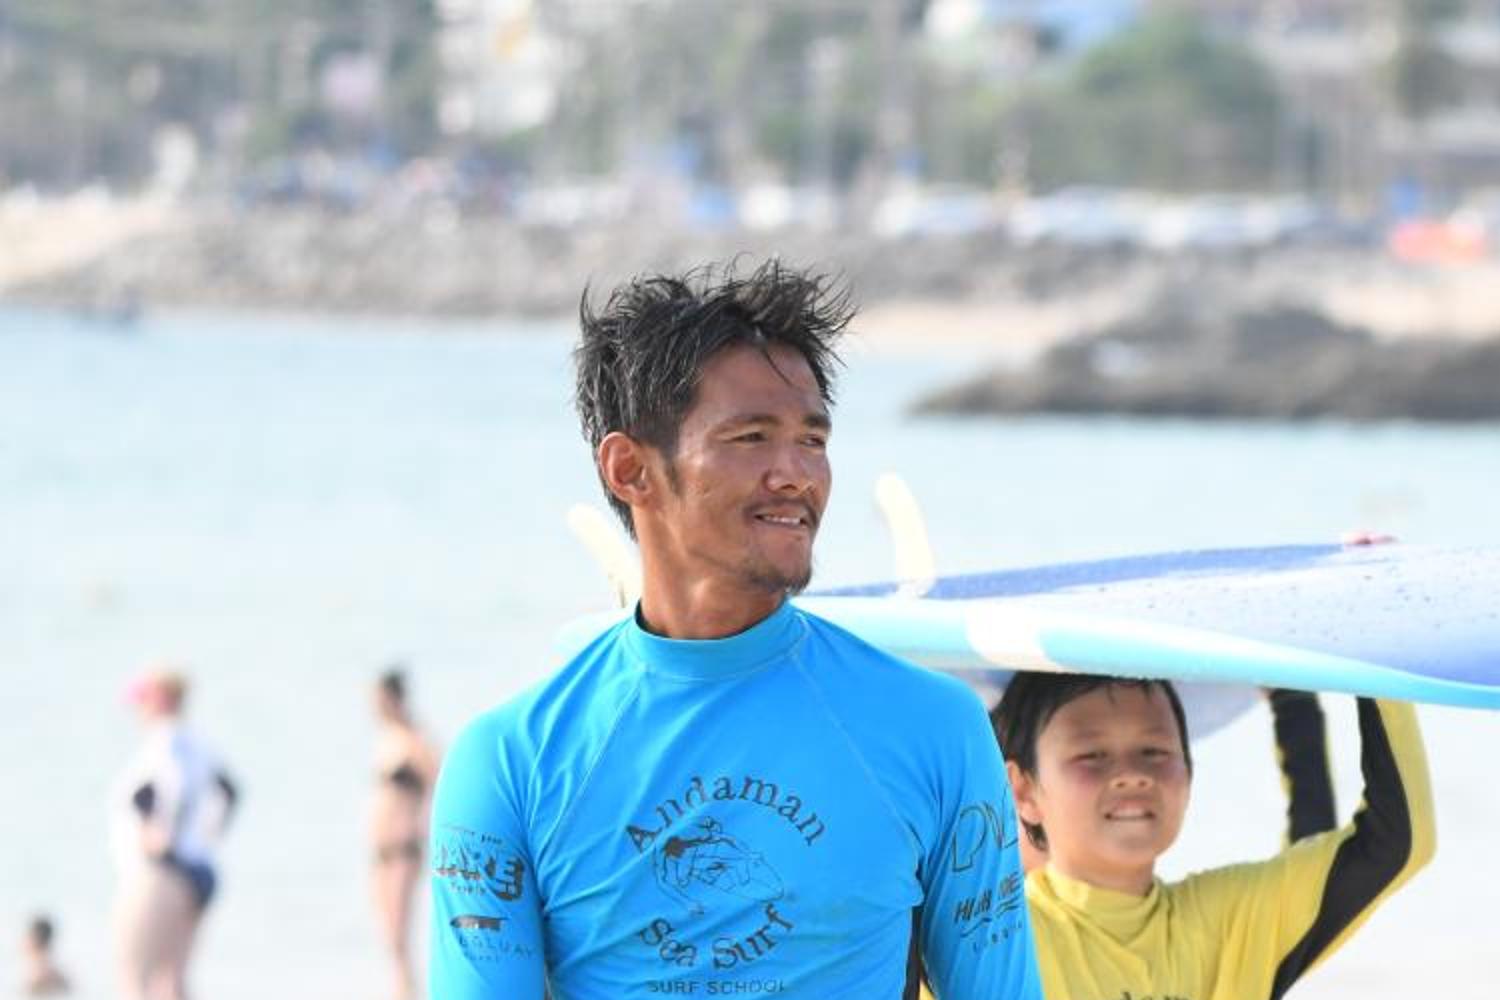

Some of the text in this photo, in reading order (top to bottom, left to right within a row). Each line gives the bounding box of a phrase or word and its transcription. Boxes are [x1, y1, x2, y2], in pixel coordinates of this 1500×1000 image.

[626, 775, 826, 853] Andaman
[639, 902, 793, 970] Sea Surf
[649, 980, 701, 994] SURF
